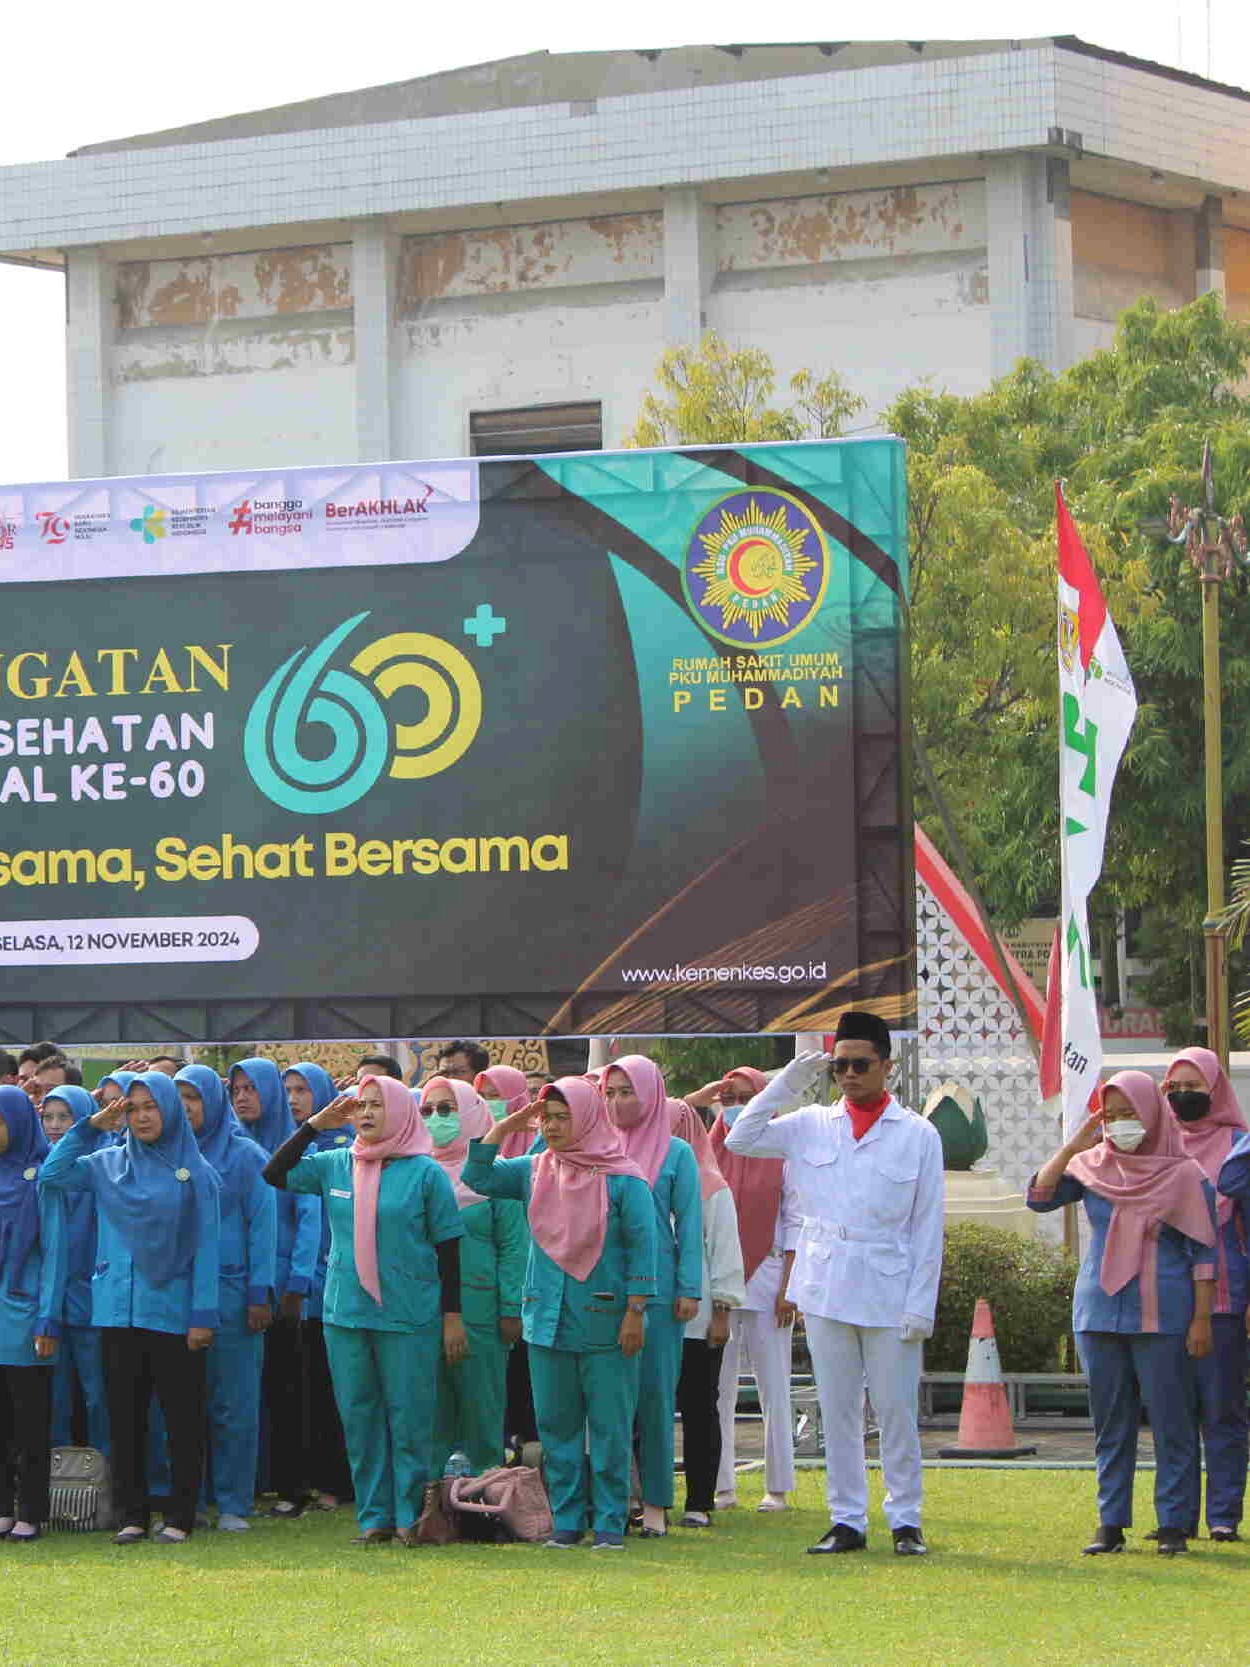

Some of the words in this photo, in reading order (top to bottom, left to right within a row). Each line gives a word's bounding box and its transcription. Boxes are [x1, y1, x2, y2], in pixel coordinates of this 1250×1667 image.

[253, 498, 303, 512] bangga
[325, 499, 428, 518] BerAKHLAK
[253, 509, 313, 523] melayani
[253, 521, 302, 536] bangsa
[672, 656, 731, 671] RUMAH
[736, 654, 783, 669] SAKIT
[789, 652, 840, 667] UMUM
[669, 671, 702, 685] PKU
[706, 666, 843, 683] MUHAMMADIYAH
[70, 759, 206, 802] KE-60
[155, 833, 315, 882] Sehat
[324, 831, 568, 877] Bersama
[68, 935, 84, 951] 12
[87, 931, 194, 950] NOVEMBER
[197, 931, 240, 948] 2024
[621, 961, 827, 984] www.kemenkes.go.id
